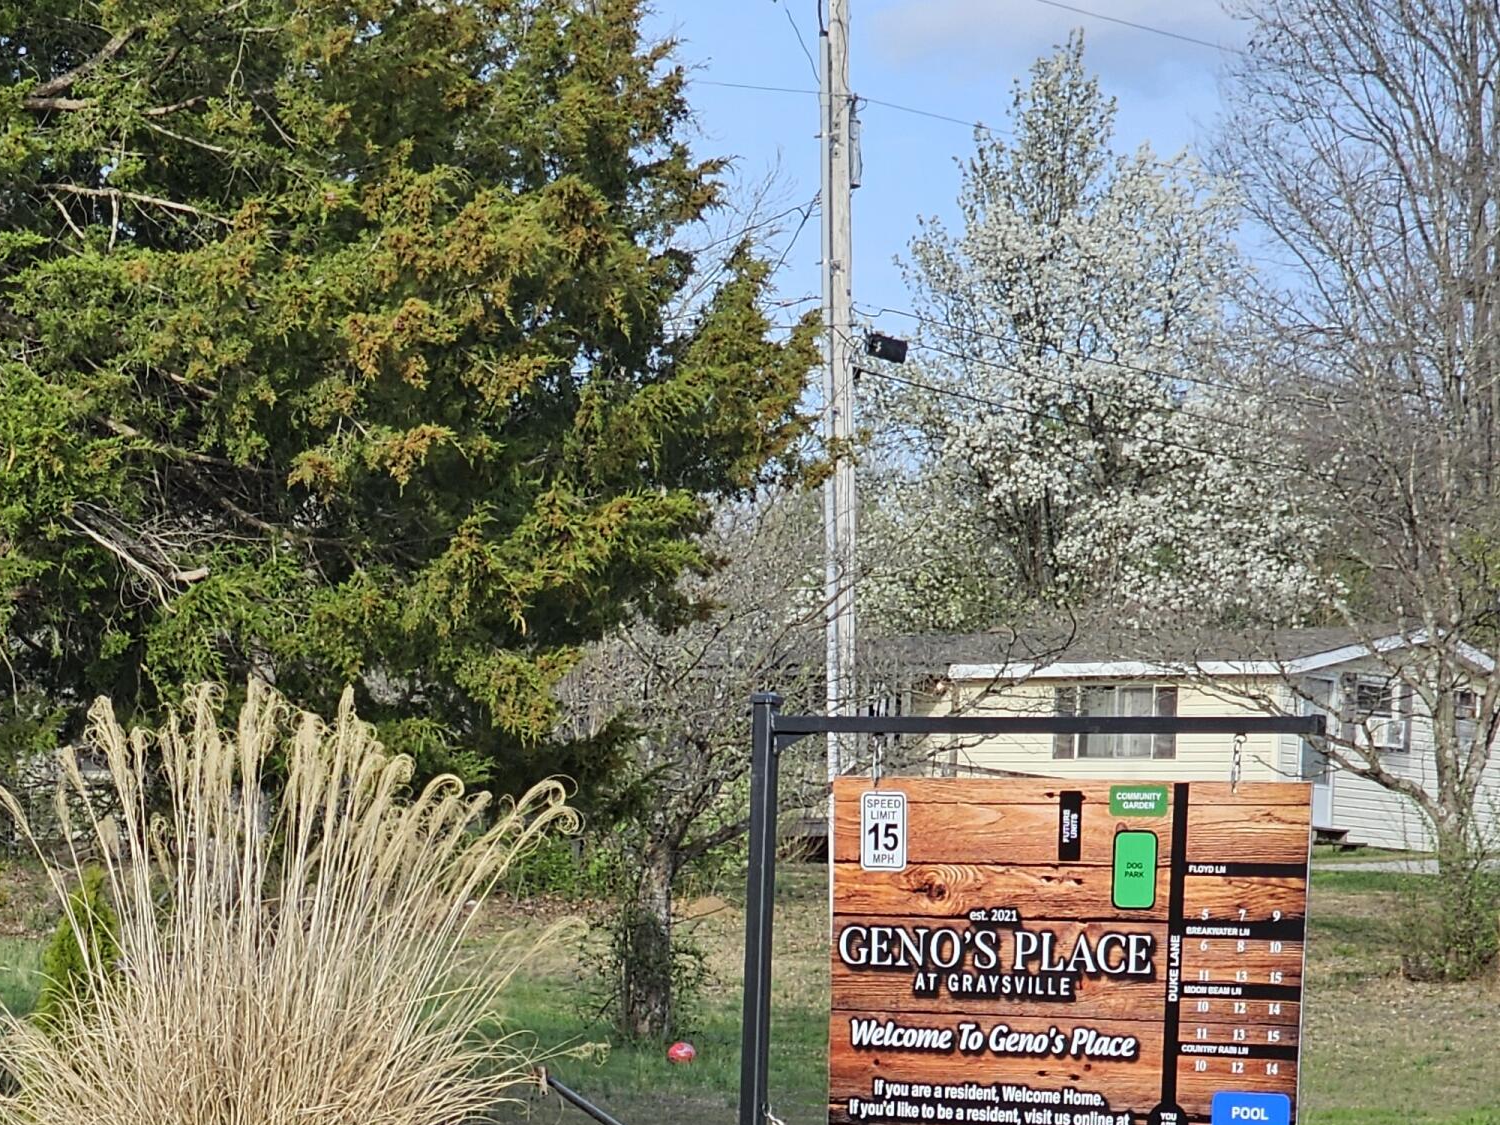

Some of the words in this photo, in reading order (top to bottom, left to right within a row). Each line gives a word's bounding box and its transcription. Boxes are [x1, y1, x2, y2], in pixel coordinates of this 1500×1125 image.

[1116, 792, 1162, 801] COMMUNITY
[866, 799, 901, 809] SPEED
[1122, 801, 1155, 810] GARDEN
[870, 811, 897, 820] LIMIT
[1062, 809, 1071, 843] FUTURE
[1070, 813, 1078, 839] UNITS
[868, 823, 899, 851] 15
[872, 854, 895, 864] MPH
[1188, 865, 1214, 873] FLOYD
[1215, 866, 1226, 874] LN
[969, 911, 988, 921] est.
[991, 909, 1017, 922] 2021
[1201, 908, 1209, 921] 5
[1238, 909, 1247, 921] 7
[1272, 910, 1281, 922] 9
[1185, 926, 1238, 936] BREAKWATER
[1239, 928, 1251, 936] LN
[839, 926, 997, 969] GENO'S
[1013, 931, 1152, 974] PLACE
[1169, 935, 1181, 967] LANE
[1200, 940, 1208, 951] 6
[1236, 941, 1245, 952] 8
[1269, 941, 1282, 953] 10
[1199, 969, 1210, 981] 11
[1235, 971, 1248, 982] 13
[1269, 972, 1282, 984] 15
[915, 973, 937, 990] AT
[947, 974, 1071, 996] GRAYSVILLE
[1168, 968, 1180, 1003] DUKE
[1183, 986, 1206, 994] MOON
[1207, 986, 1230, 995] BEAM
[1231, 987, 1243, 996] LN
[1197, 1001, 1209, 1013] 10
[1233, 1002, 1246, 1014] 12
[1267, 1003, 1280, 1015] 14
[851, 1019, 952, 1049] Welcome
[958, 1023, 984, 1050] To
[989, 1024, 1064, 1054] Geno's
[1070, 1027, 1136, 1057] Place
[1196, 1028, 1207, 1040] 11
[1232, 1029, 1245, 1041] 13
[1267, 1030, 1280, 1042] 15
[1181, 1044, 1217, 1053] COUNTRY
[1218, 1046, 1237, 1055] RAIN
[1238, 1047, 1249, 1055] LN
[1194, 1060, 1206, 1072] 10
[1231, 1061, 1244, 1074] 12
[1266, 1062, 1278, 1075] 14
[874, 1079, 885, 1096] If
[885, 1084, 909, 1100] you
[911, 1085, 932, 1098] are
[934, 1086, 942, 1098] a
[944, 1083, 1000, 1103] resident,
[1002, 1085, 1061, 1105] Welcome
[1063, 1088, 1105, 1107] Home.
[849, 1099, 860, 1115] If
[860, 1100, 895, 1119] you'd
[897, 1101, 920, 1118] like
[921, 1105, 935, 1119] to
[937, 1103, 953, 1120] be
[955, 1108, 964, 1121] a
[966, 1105, 1022, 1125] resident,
[1024, 1109, 1053, 1125] visit
[1160, 1112, 1177, 1121] YOU
[1231, 1106, 1269, 1121] POOL
